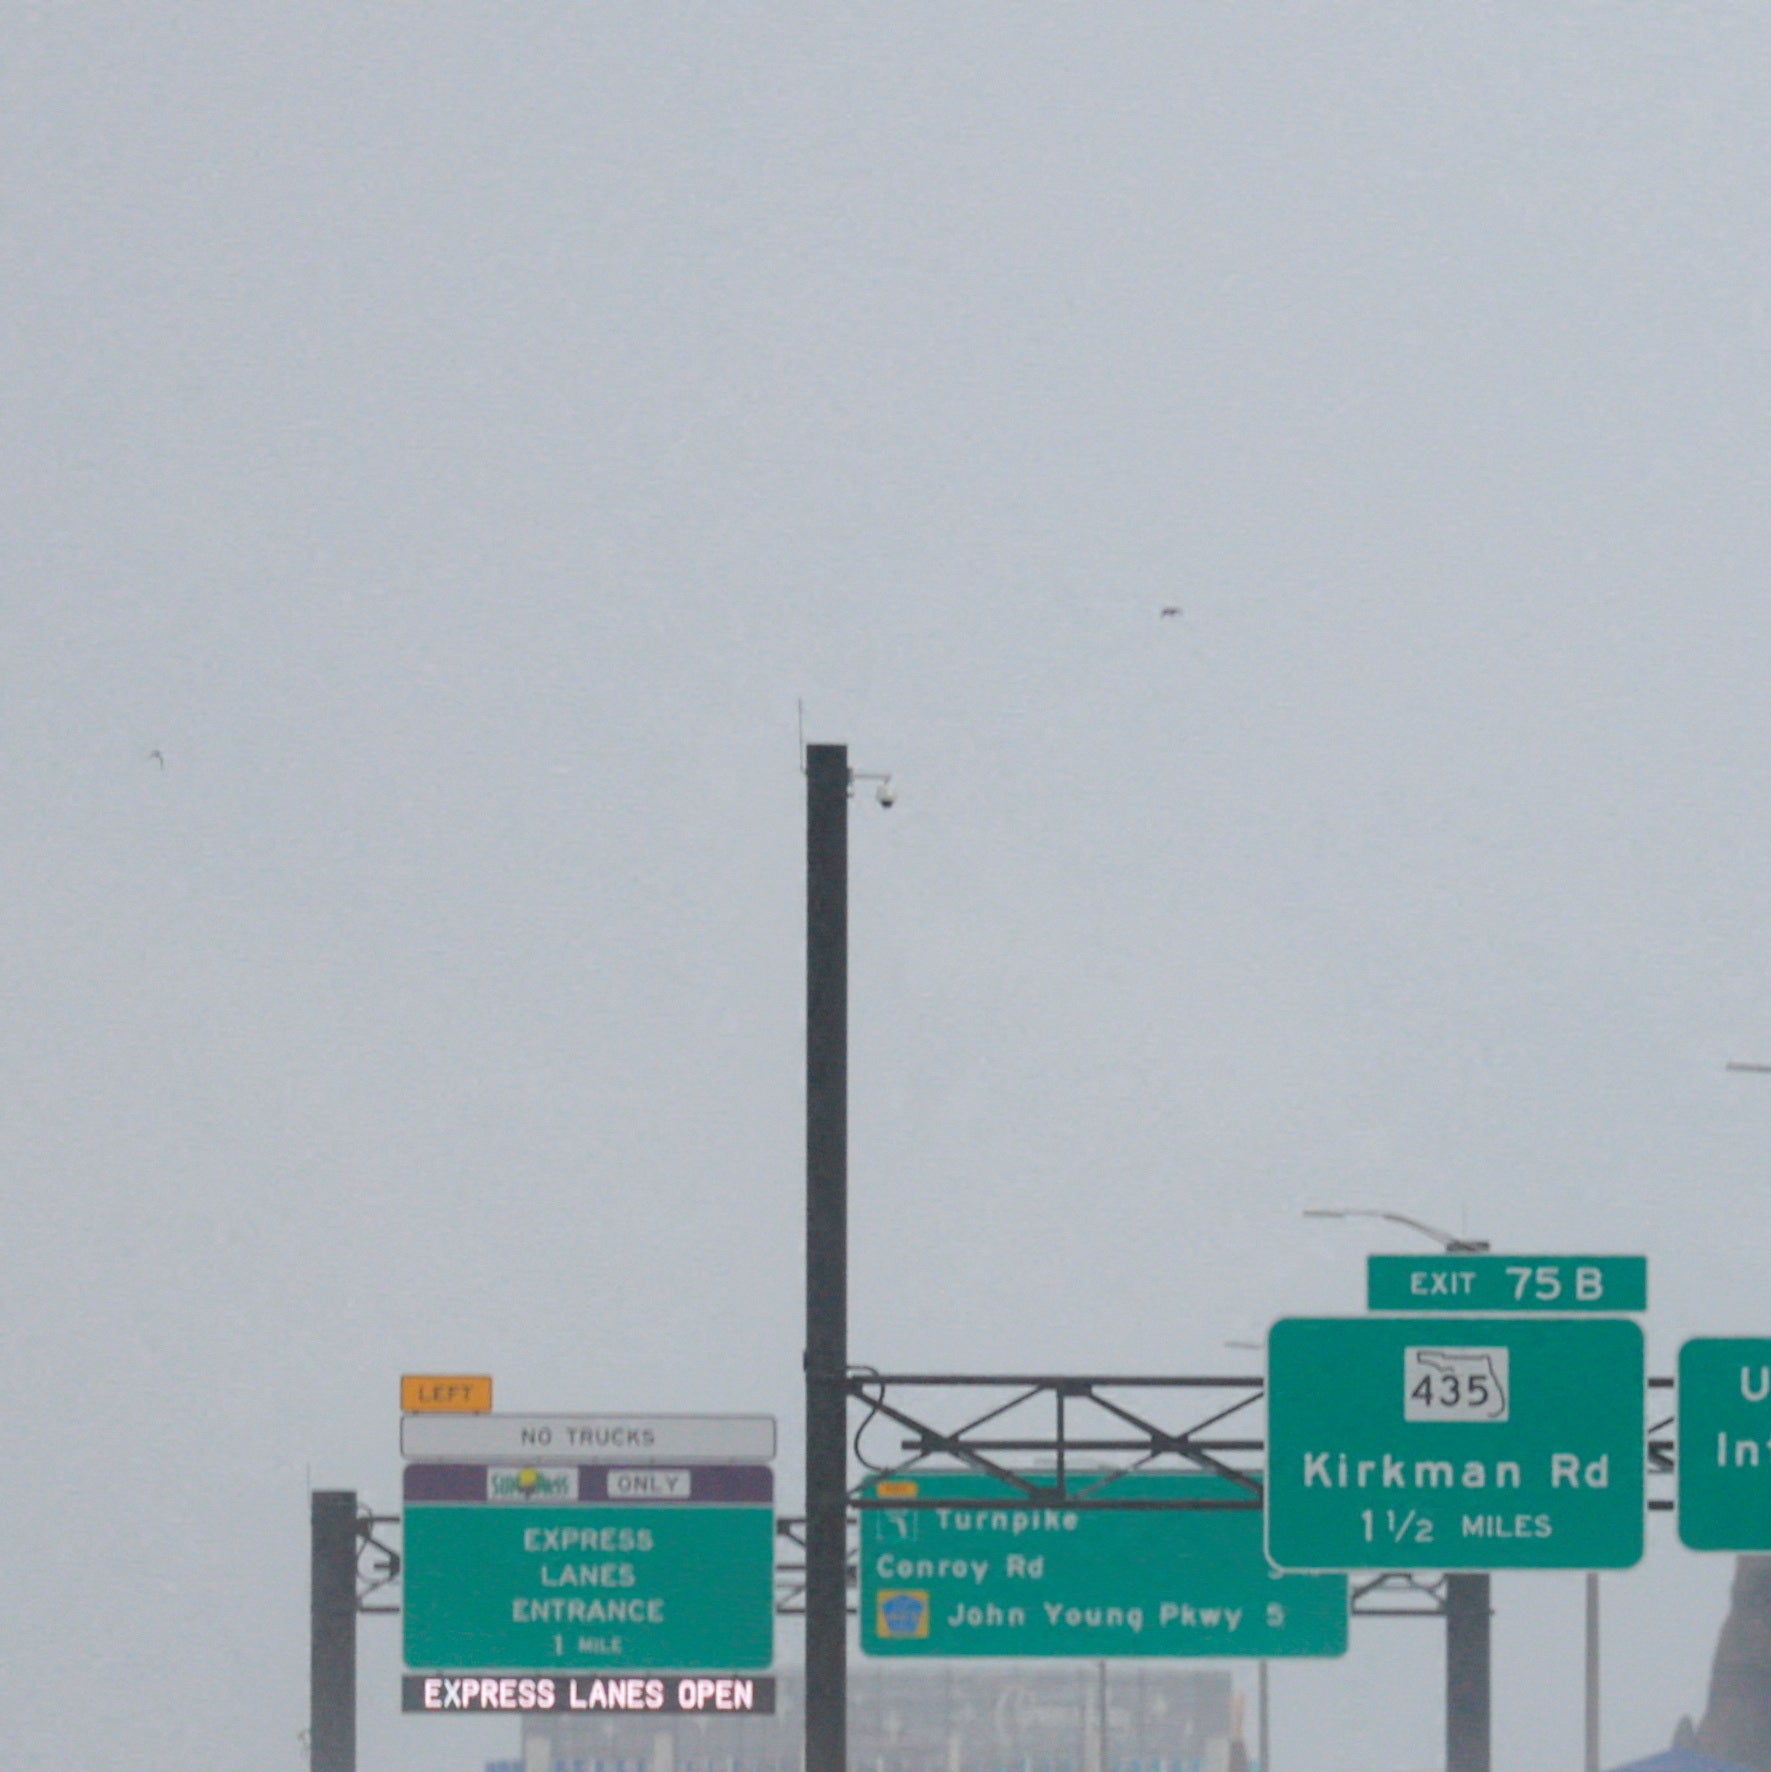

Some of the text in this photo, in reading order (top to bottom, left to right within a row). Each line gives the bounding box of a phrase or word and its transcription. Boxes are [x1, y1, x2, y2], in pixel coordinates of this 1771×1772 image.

[1411, 1267, 1602, 1300] EXIT 75 B
[418, 1384, 471, 1402] LEFT
[1412, 1374, 1489, 1407] 435
[521, 1427, 655, 1446] NO TRUCKS
[617, 1472, 679, 1492] ONLY
[1304, 1453, 1607, 1488] Kirkman Rd
[937, 1508, 1077, 1532] Turnpike
[1463, 1515, 1551, 1537] MILES
[525, 1529, 652, 1550] EXPRESS
[542, 1564, 635, 1586] LANES
[877, 1554, 1043, 1584] Conroy Rd
[513, 1599, 662, 1622] ENTRANCE
[948, 1603, 1025, 1626] John
[1044, 1603, 1143, 1632] Young
[1160, 1603, 1241, 1630] Pkwy
[554, 1635, 621, 1655] 1 MILE
[424, 1679, 753, 1709] EXPRESS LANES OPEN
